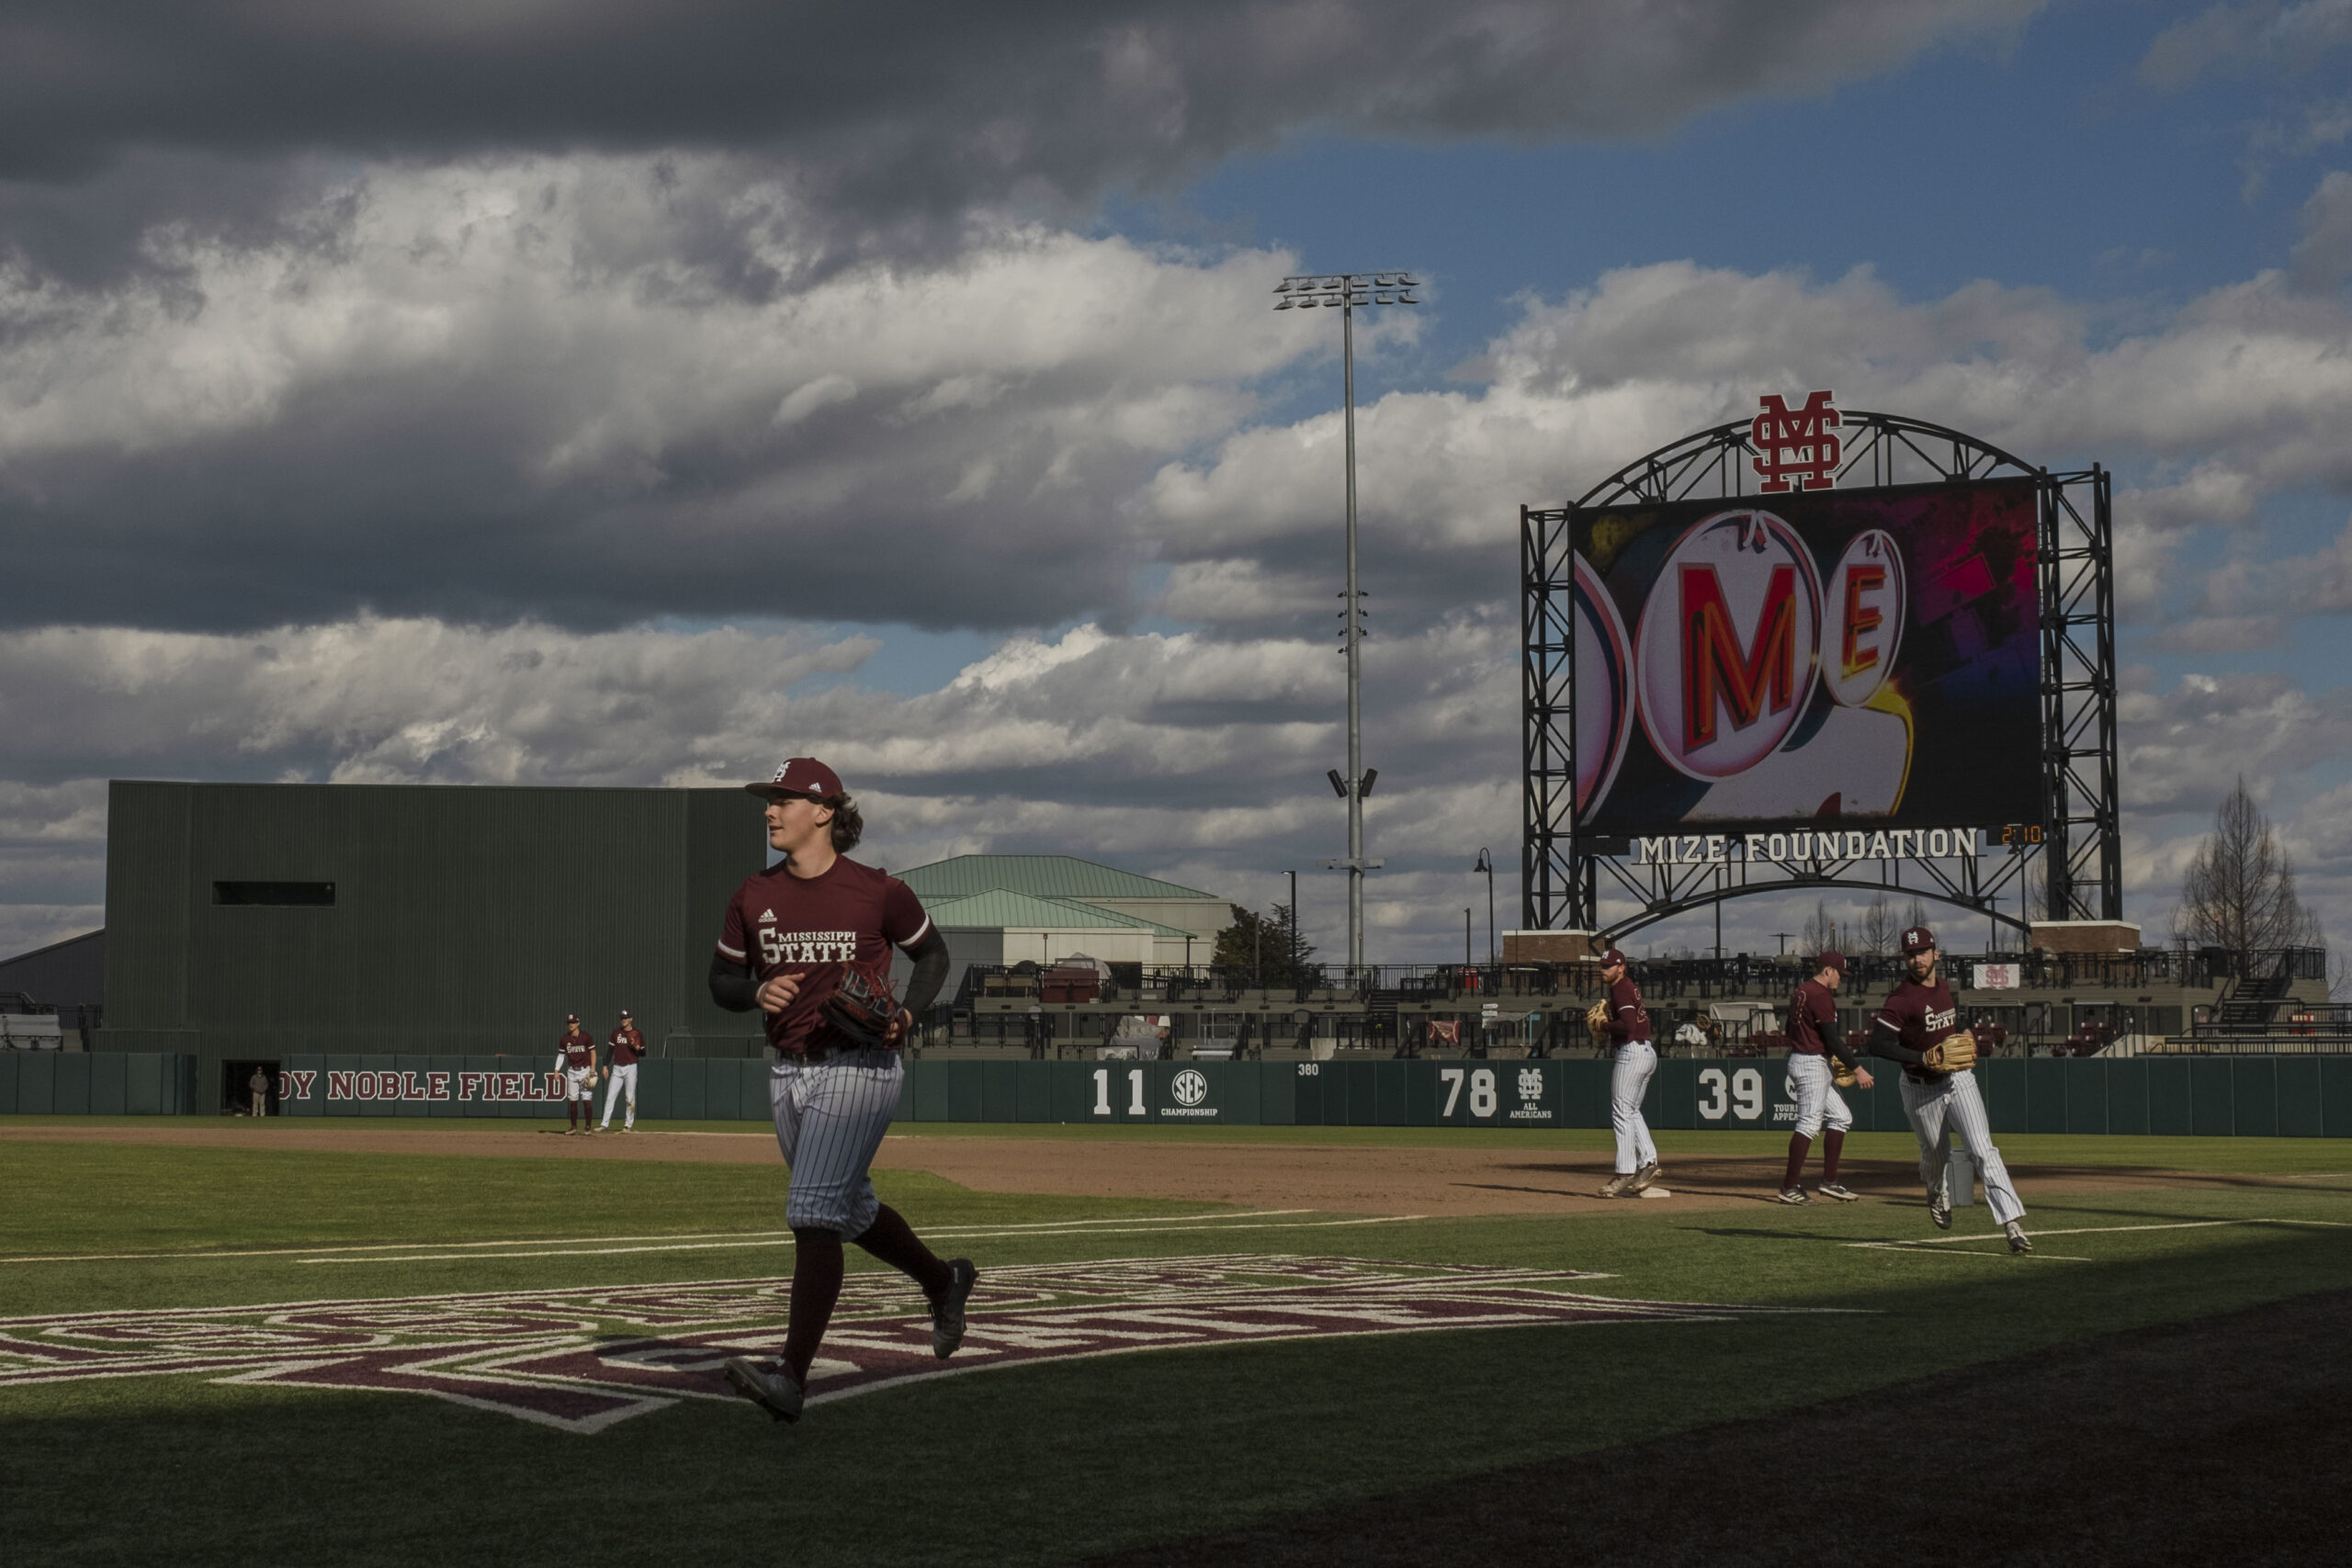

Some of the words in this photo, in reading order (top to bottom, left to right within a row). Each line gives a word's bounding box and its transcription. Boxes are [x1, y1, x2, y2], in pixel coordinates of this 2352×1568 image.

[1638, 834, 1726, 865] MIZE
[1745, 827, 1979, 863] FOUNDATION
[2001, 825, 2041, 843] 2:10
[758, 927, 856, 964] STATE
[777, 931, 857, 943] MISSISSIPPI
[1298, 1063, 1319, 1077] 380
[328, 1070, 450, 1101] NOBLE
[458, 1071, 568, 1102] FIELD
[1174, 1072, 1204, 1104] SEC
[1441, 1068, 1498, 1118] 78
[1698, 1067, 1764, 1121] 39
[1160, 1108, 1218, 1117] CHAMPIONSHIP
[1510, 1111, 1553, 1119] AMERICANS
[1523, 1102, 1538, 1111] ALL
